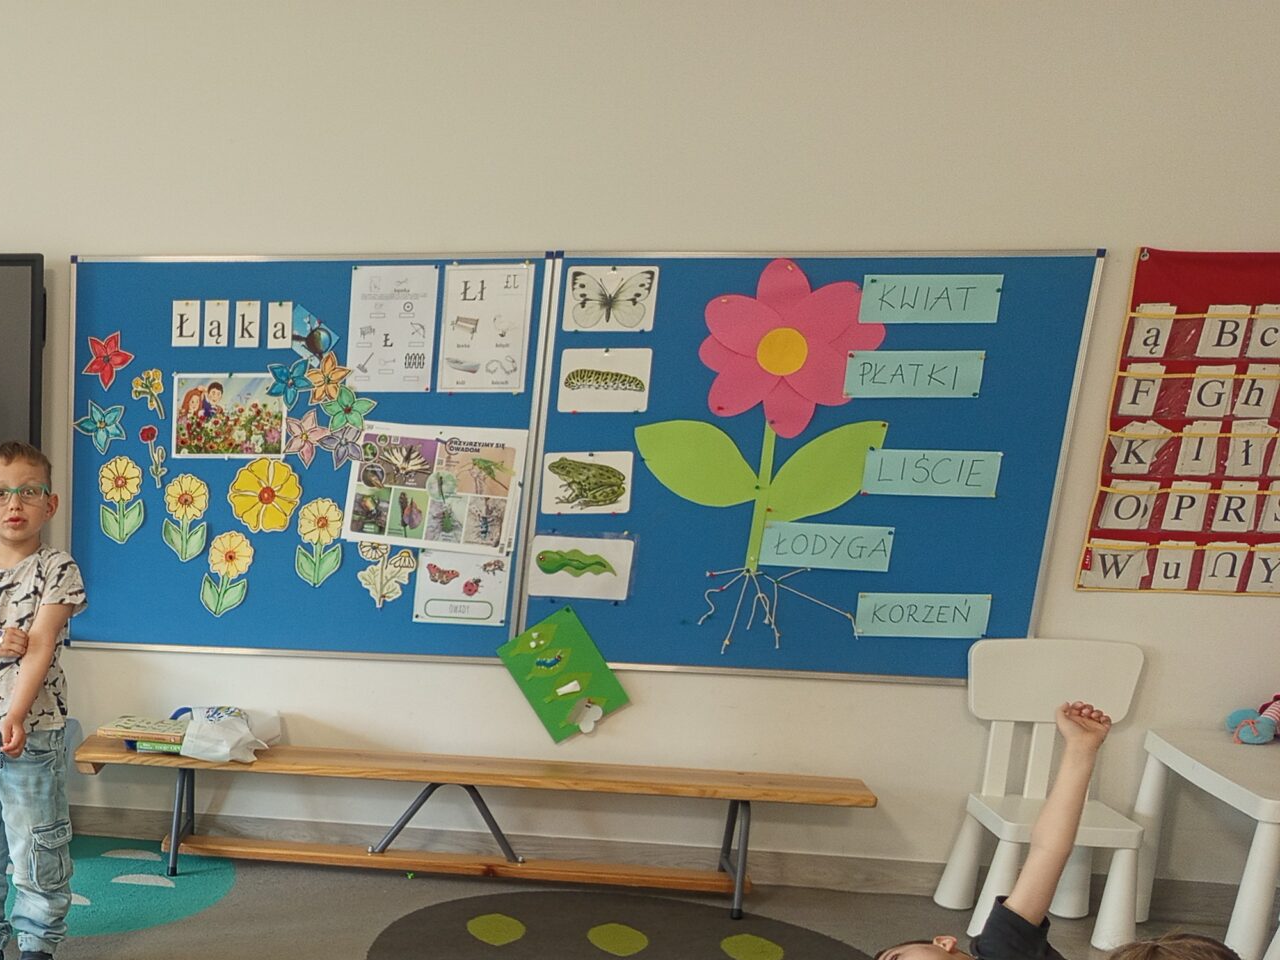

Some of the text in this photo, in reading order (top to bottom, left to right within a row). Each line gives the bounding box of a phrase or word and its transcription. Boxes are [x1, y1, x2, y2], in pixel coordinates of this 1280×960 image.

[879, 284, 977, 311] KWIAT
[1212, 319, 1240, 347] B
[859, 362, 958, 391] PŁATKI
[1128, 378, 1265, 408] F G h
[449, 445, 480, 453] OWADOM
[1120, 438, 1149, 465] K
[877, 454, 985, 487] LIŚCIE
[1171, 494, 1196, 521] P
[1218, 495, 1246, 523] R
[774, 533, 888, 559] ŁODYGA
[1098, 553, 1134, 580] W
[871, 599, 971, 624] KORZEŃ
